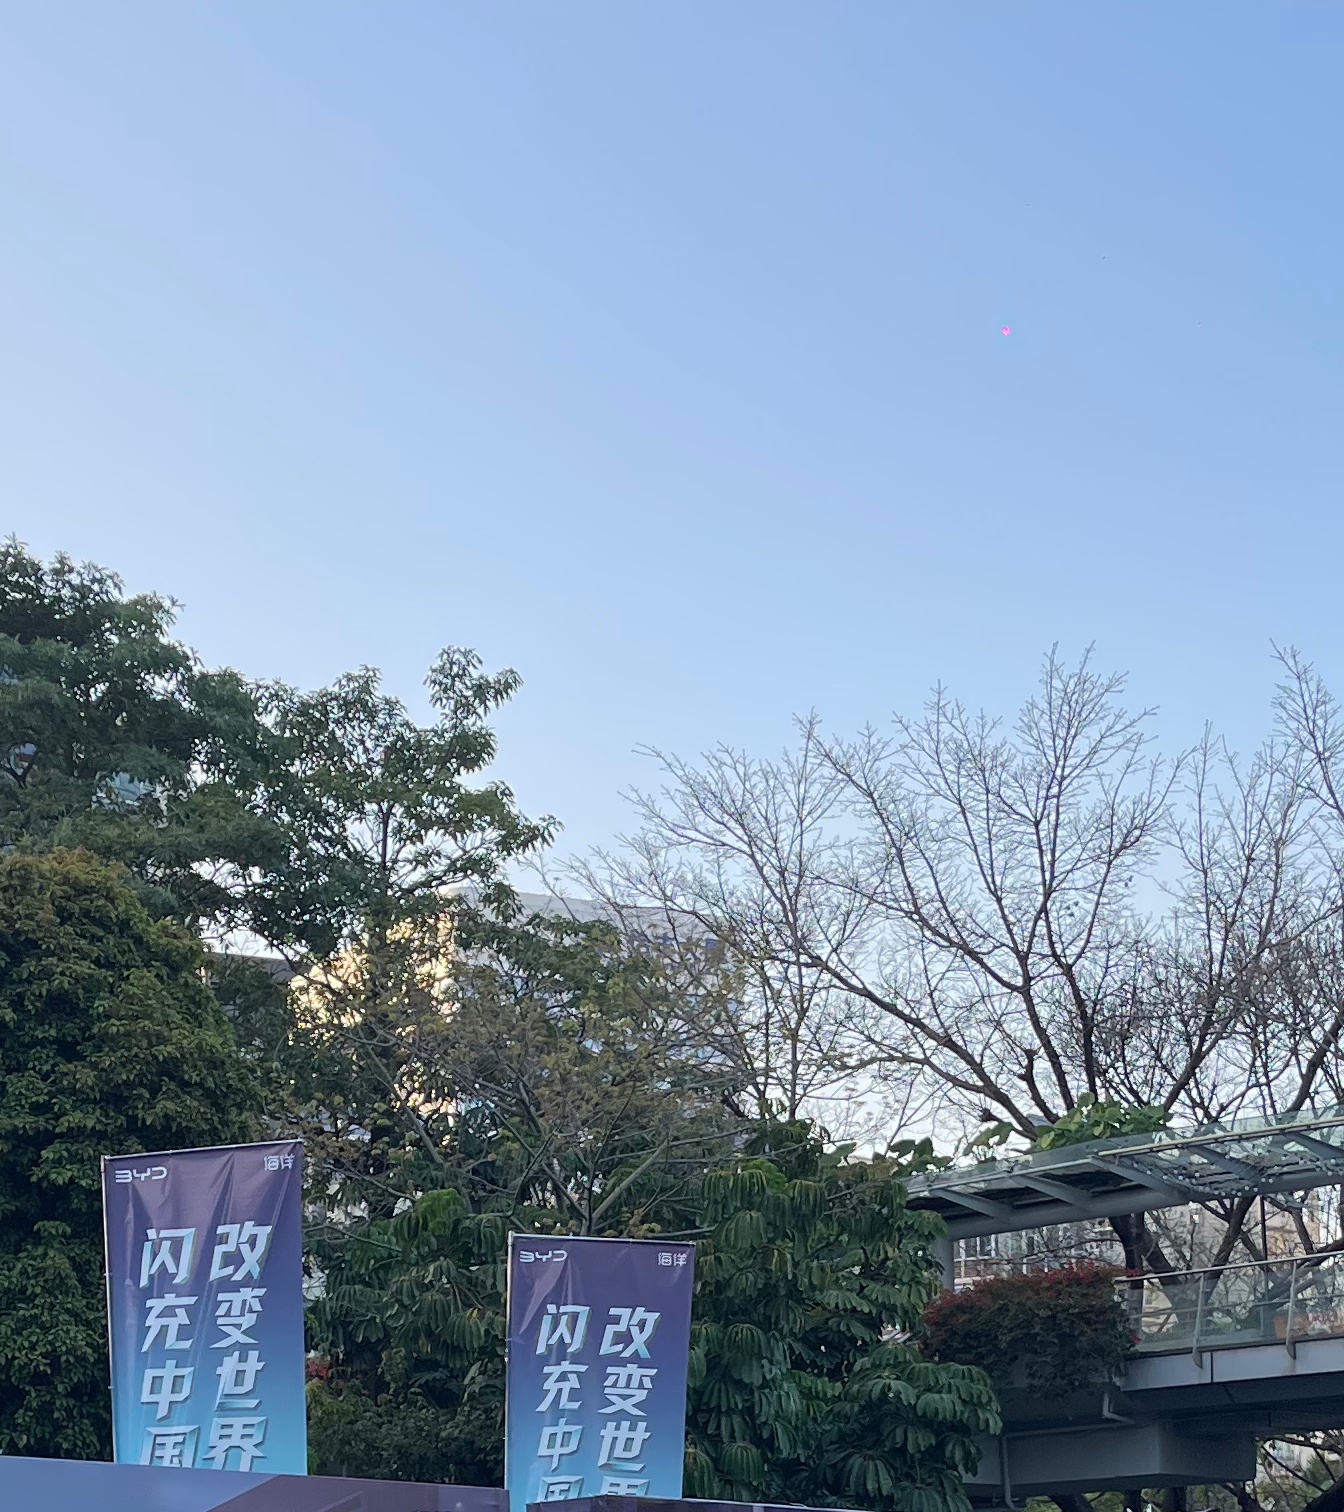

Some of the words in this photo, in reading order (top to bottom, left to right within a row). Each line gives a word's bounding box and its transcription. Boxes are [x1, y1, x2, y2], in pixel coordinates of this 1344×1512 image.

[263, 1154, 296, 1171] 海洋
[114, 1167, 168, 1183] BYD
[519, 1250, 568, 1263] BYD
[657, 1252, 687, 1266] 海洋
